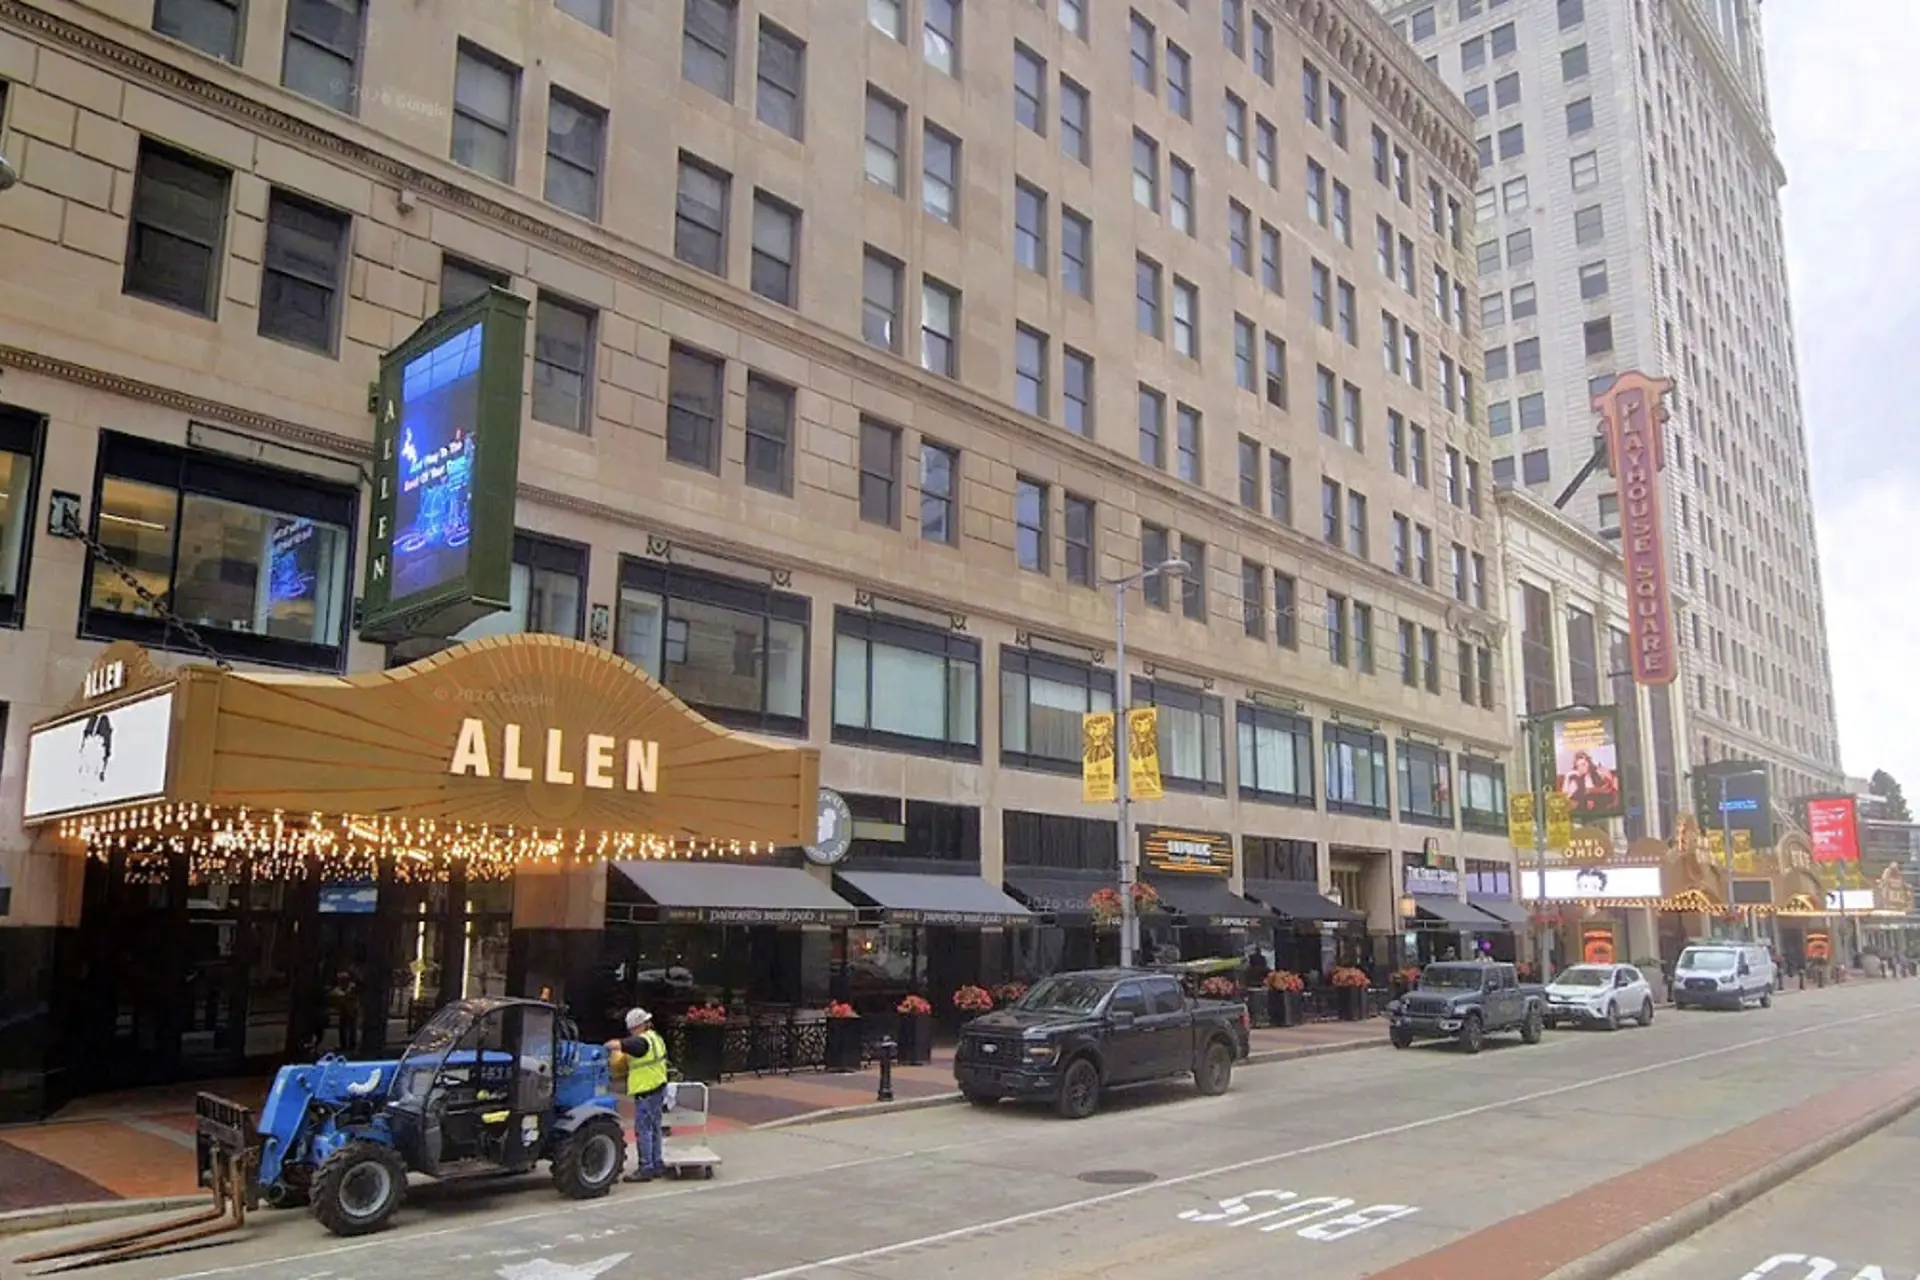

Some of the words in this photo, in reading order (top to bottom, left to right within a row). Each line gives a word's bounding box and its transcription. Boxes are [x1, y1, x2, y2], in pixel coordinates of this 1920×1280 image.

[373, 399, 395, 581] ALLEN
[1622, 401, 1650, 553] PLAYHOUSE
[1635, 567, 1662, 673] SQUARE
[83, 660, 124, 699] ALLEN
[450, 717, 659, 793] ALLEN
[1540, 739, 1553, 793] OHIO
[1563, 845, 1605, 858] OHIO
[1177, 1189, 1422, 1242] BUS
